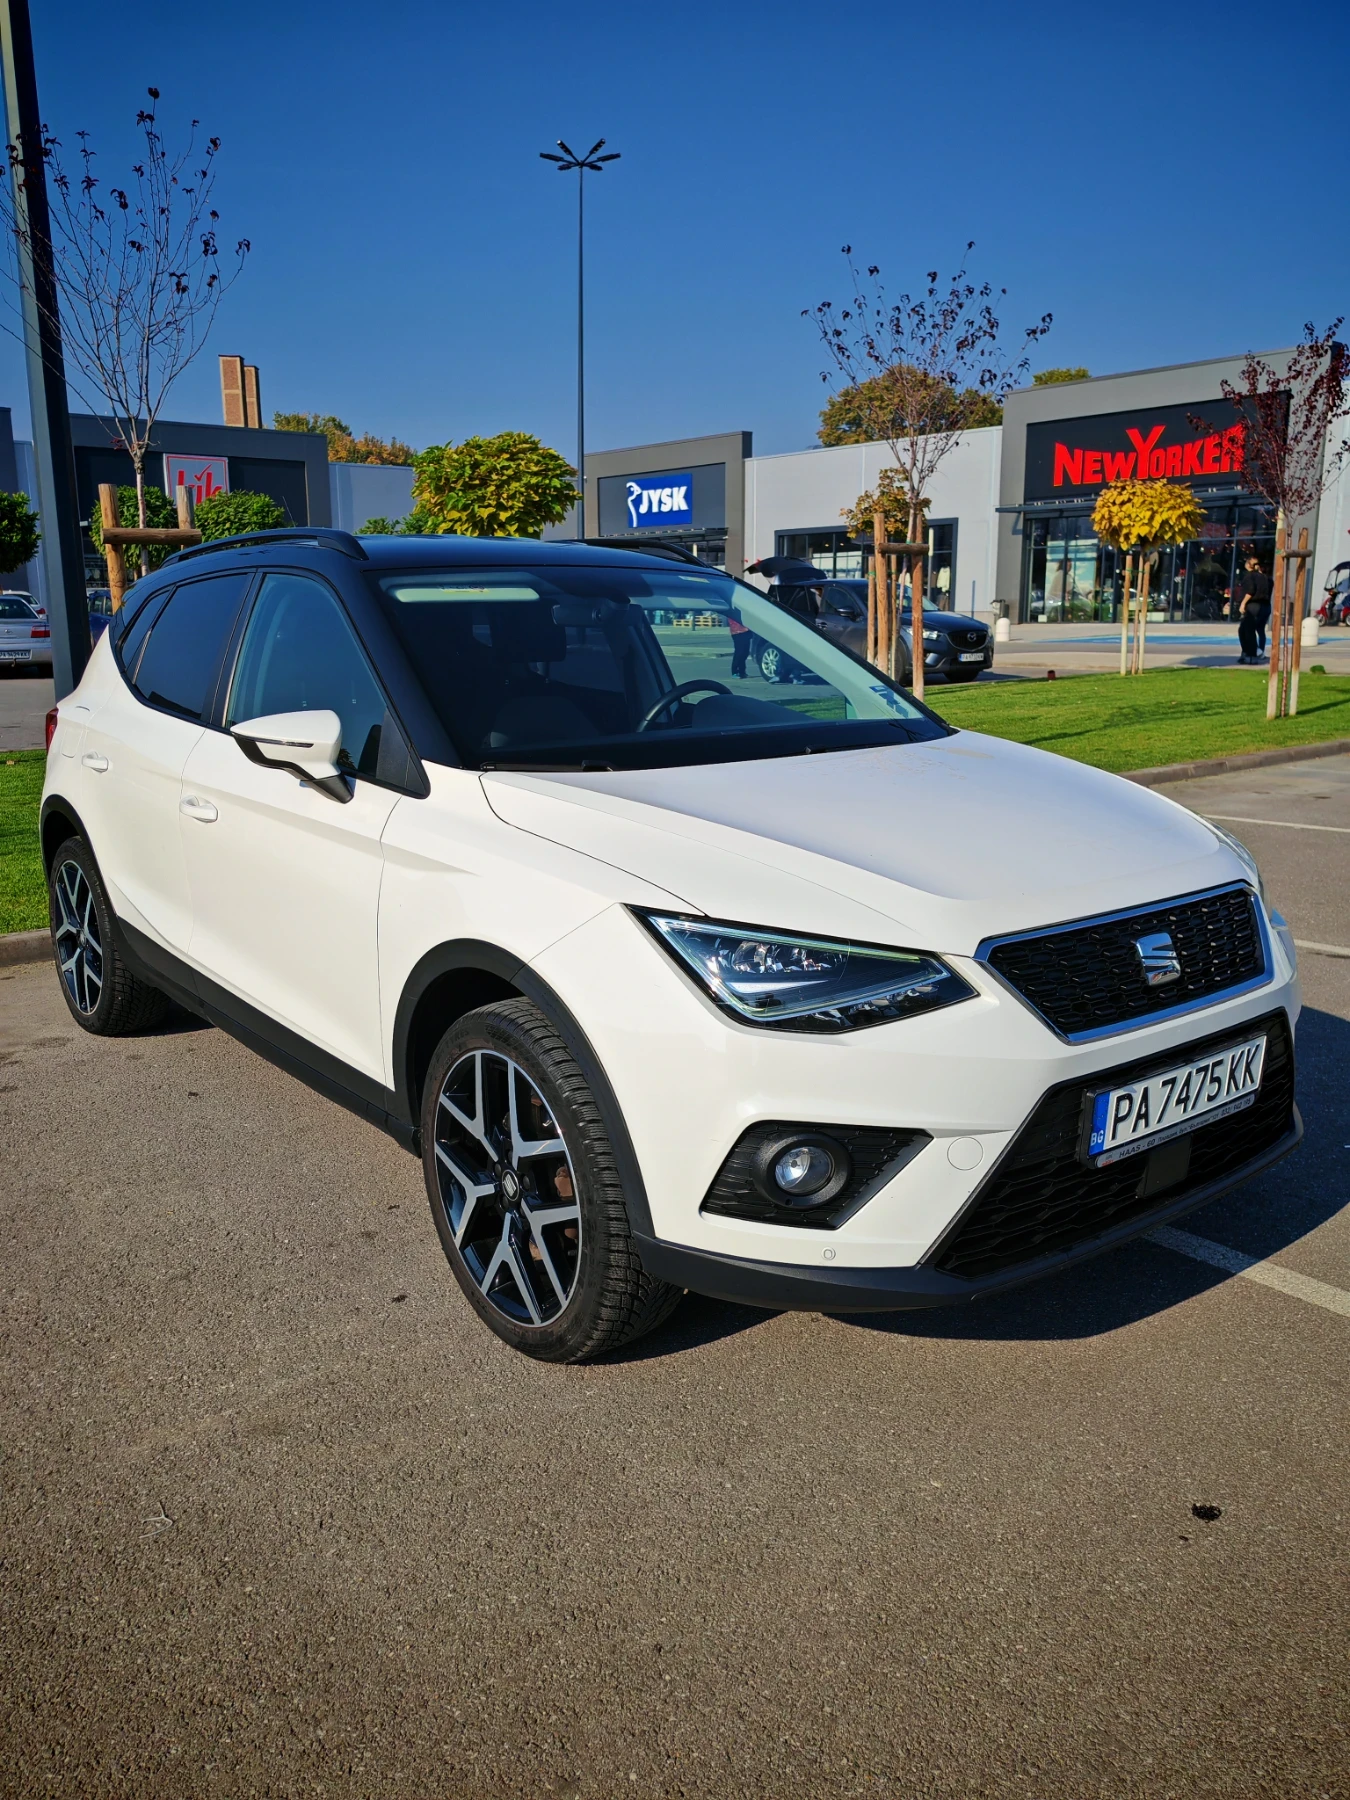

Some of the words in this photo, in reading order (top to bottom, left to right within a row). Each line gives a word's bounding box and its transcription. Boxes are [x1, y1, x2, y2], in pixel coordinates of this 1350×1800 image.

[639, 486, 689, 514] JYSK
[1110, 1087, 1150, 1142] PA
[1155, 1058, 1224, 1125] 7475
[1224, 1043, 1260, 1097] KK
[1090, 1129, 1104, 1147] BG
